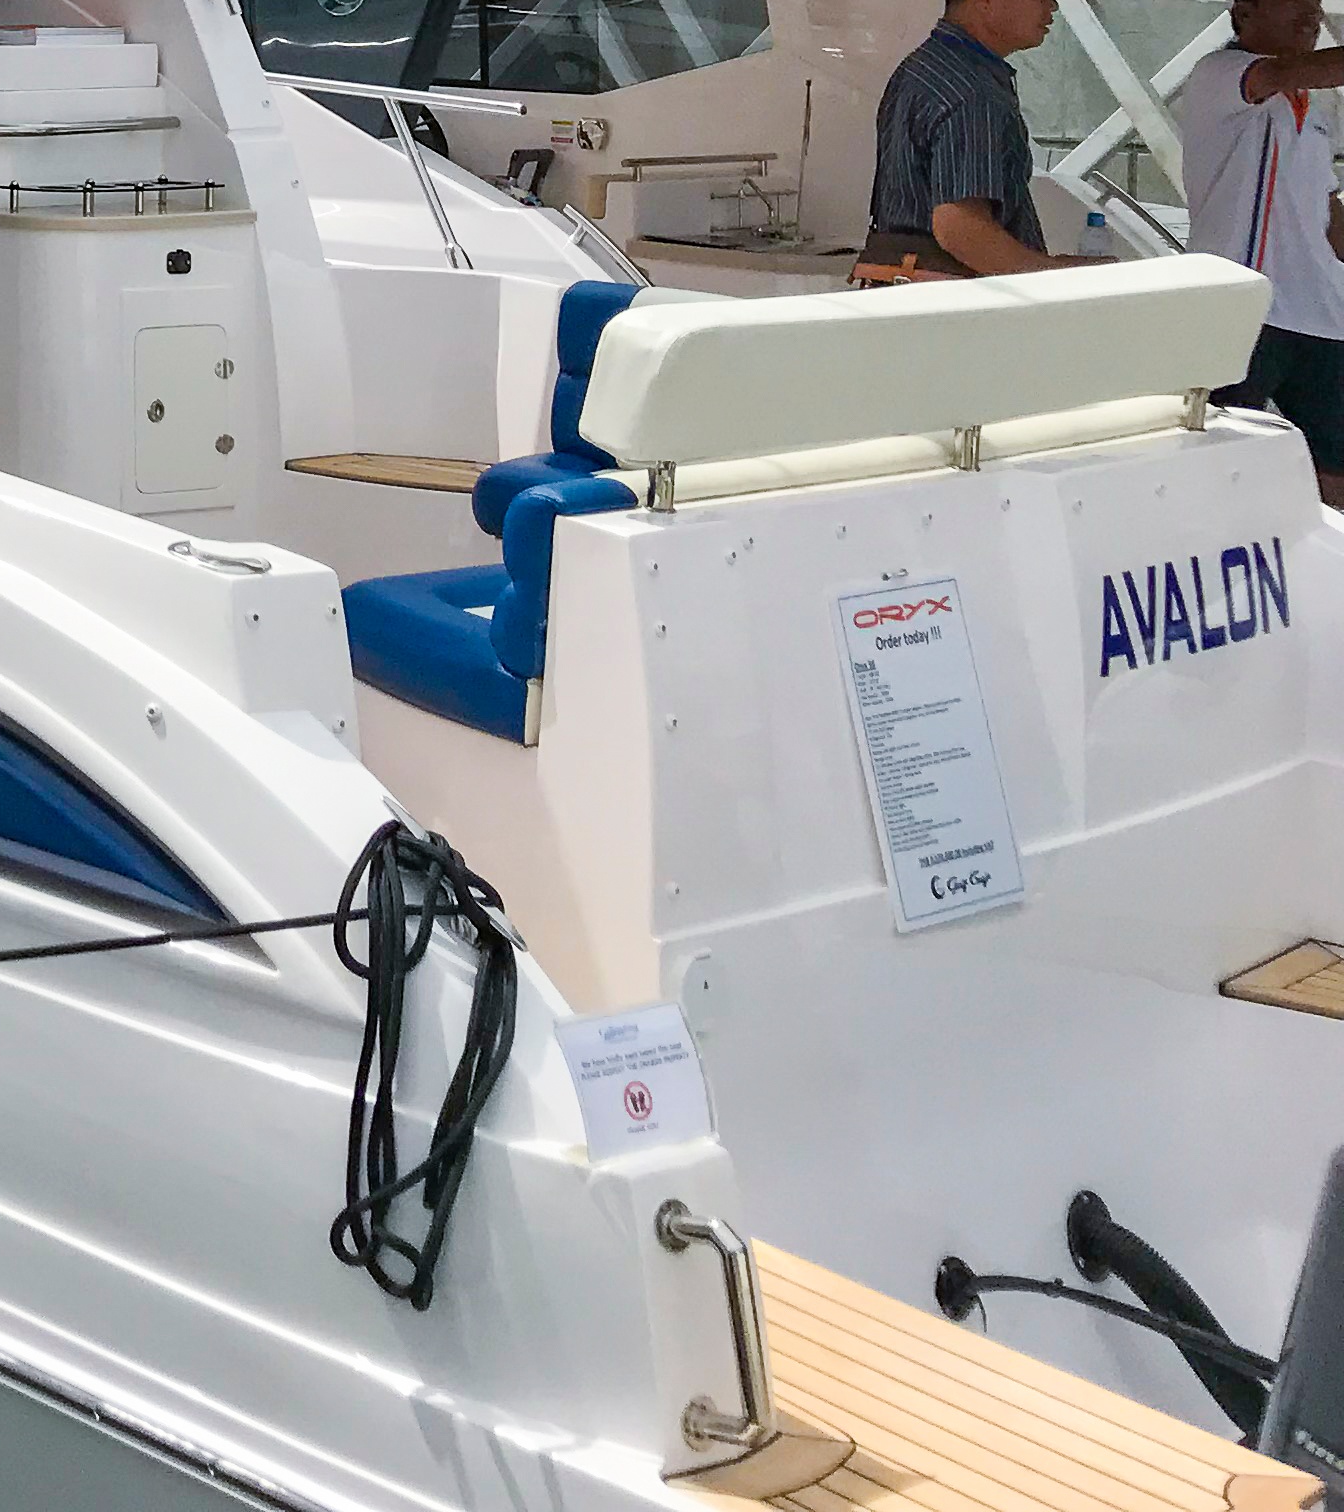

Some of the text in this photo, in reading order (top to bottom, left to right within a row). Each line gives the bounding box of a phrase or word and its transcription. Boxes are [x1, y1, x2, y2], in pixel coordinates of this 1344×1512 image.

[853, 595, 953, 629] ORYX
[1100, 536, 1290, 678] AVALON
[875, 634, 902, 651] Order
[903, 630, 930, 645] today
